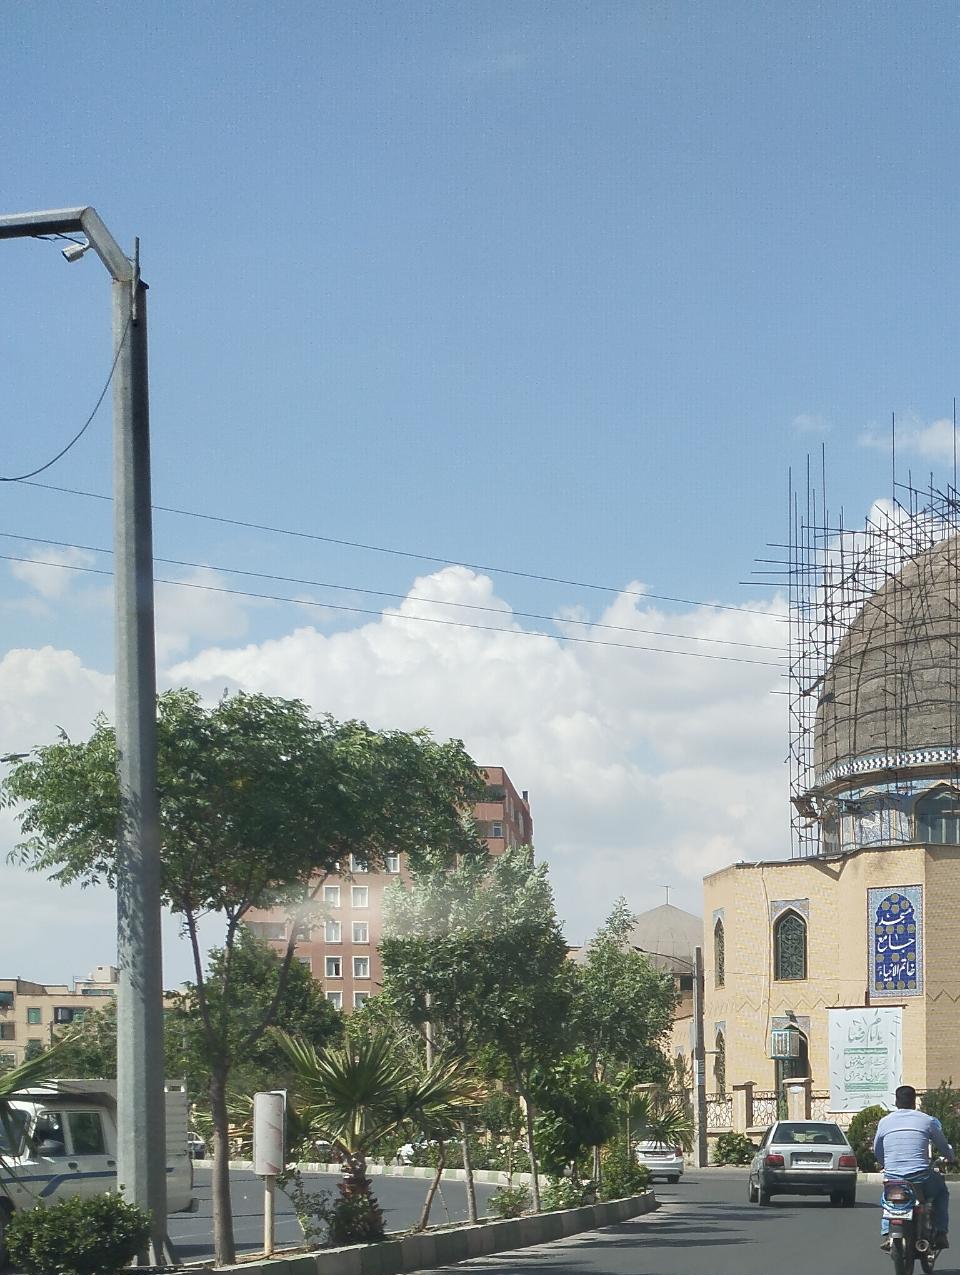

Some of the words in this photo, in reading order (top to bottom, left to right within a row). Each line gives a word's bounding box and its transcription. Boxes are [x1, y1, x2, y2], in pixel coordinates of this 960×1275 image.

[879, 907, 913, 926] مسجد
[877, 933, 915, 953] جامع
[899, 958, 916, 980] خاتم
